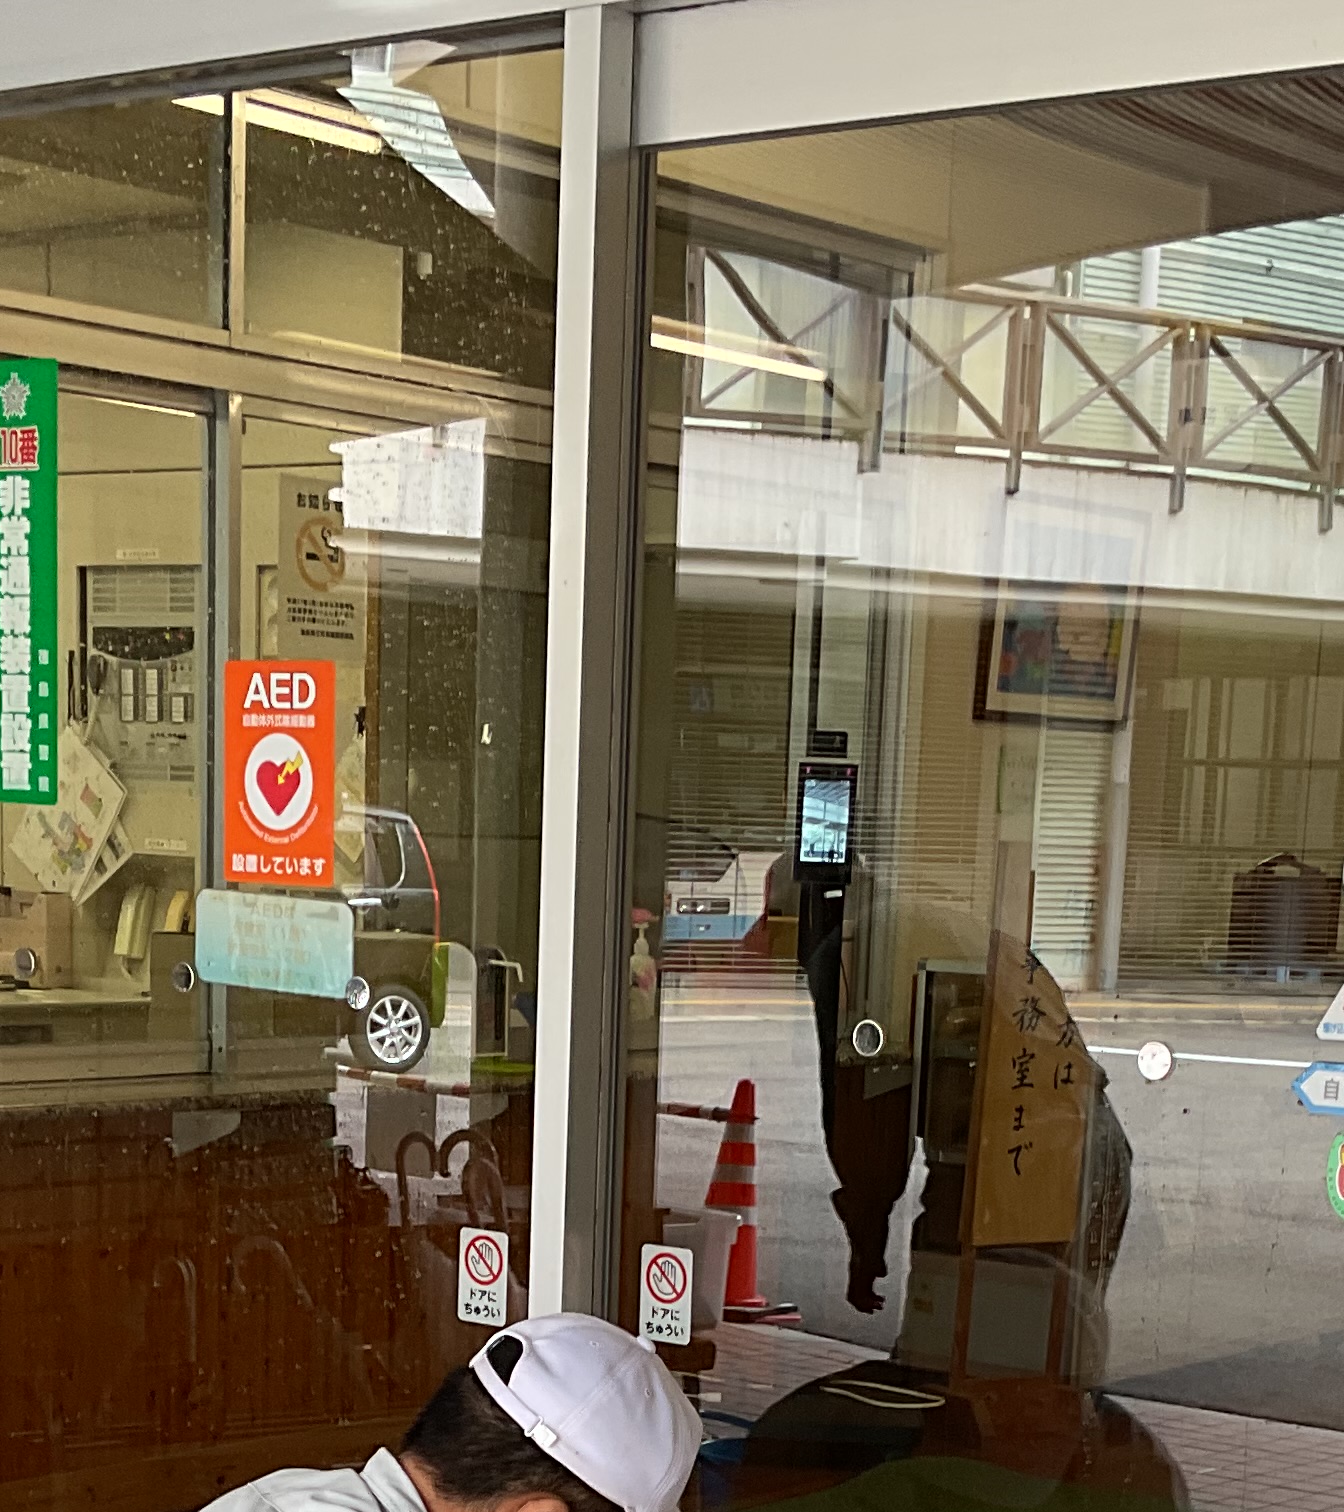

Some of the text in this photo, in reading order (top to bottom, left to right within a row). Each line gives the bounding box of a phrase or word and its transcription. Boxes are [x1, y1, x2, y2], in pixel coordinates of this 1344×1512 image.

[243, 672, 316, 710] AED
[232, 853, 326, 876] 設置しています
[469, 1288, 497, 1303] ドアに
[464, 1303, 501, 1319] ちゅうい
[651, 1306, 680, 1321] ドアに
[645, 1321, 684, 1337] ちゅうい
